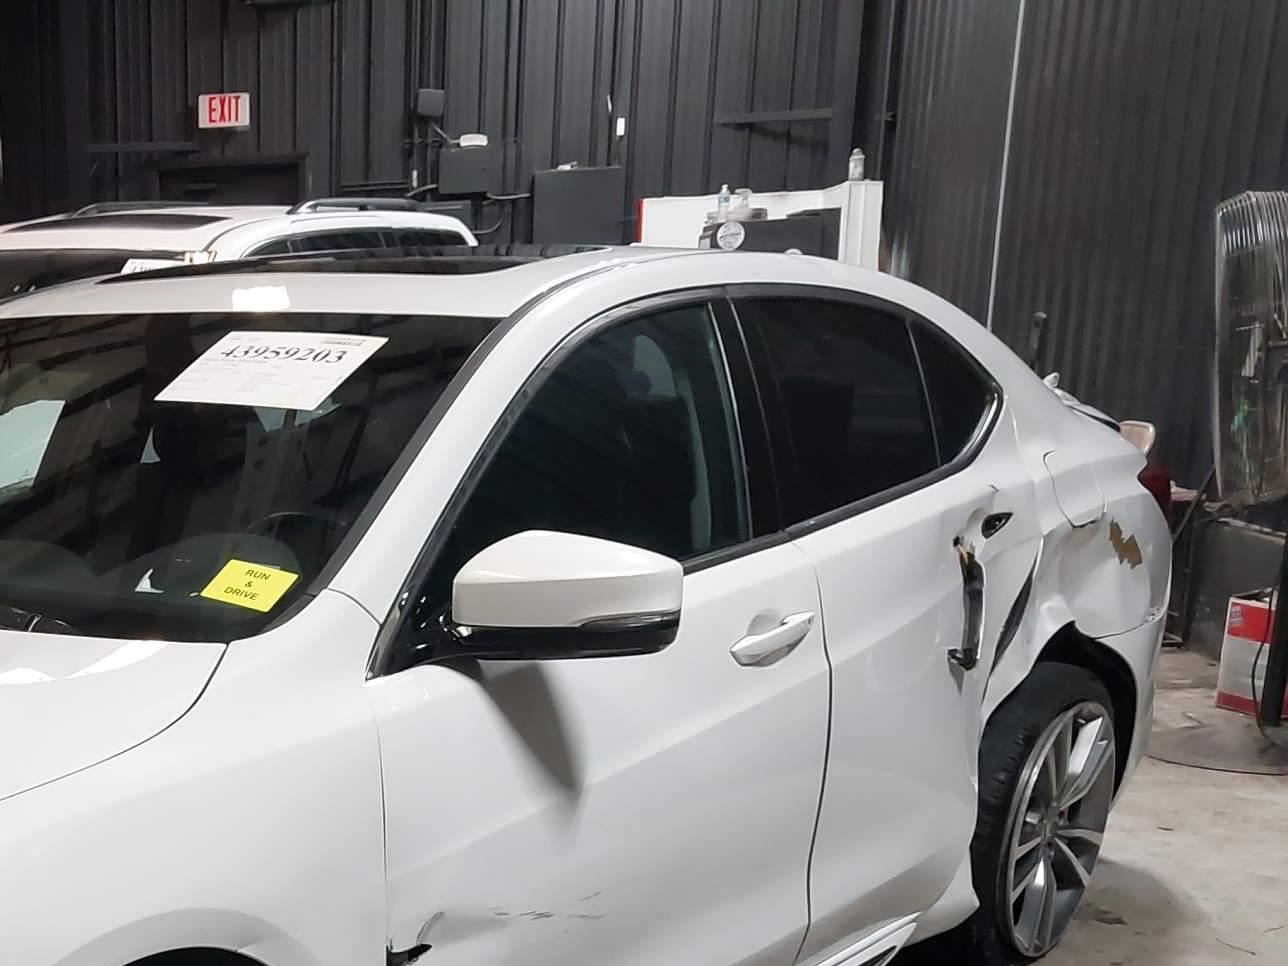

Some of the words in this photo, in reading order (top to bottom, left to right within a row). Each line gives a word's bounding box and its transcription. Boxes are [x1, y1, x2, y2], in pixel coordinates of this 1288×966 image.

[208, 95, 241, 123] EXIT
[220, 345, 347, 363] 43959203
[244, 569, 271, 581] RUN
[244, 580, 253, 588] &
[223, 586, 260, 601] DRIVE
